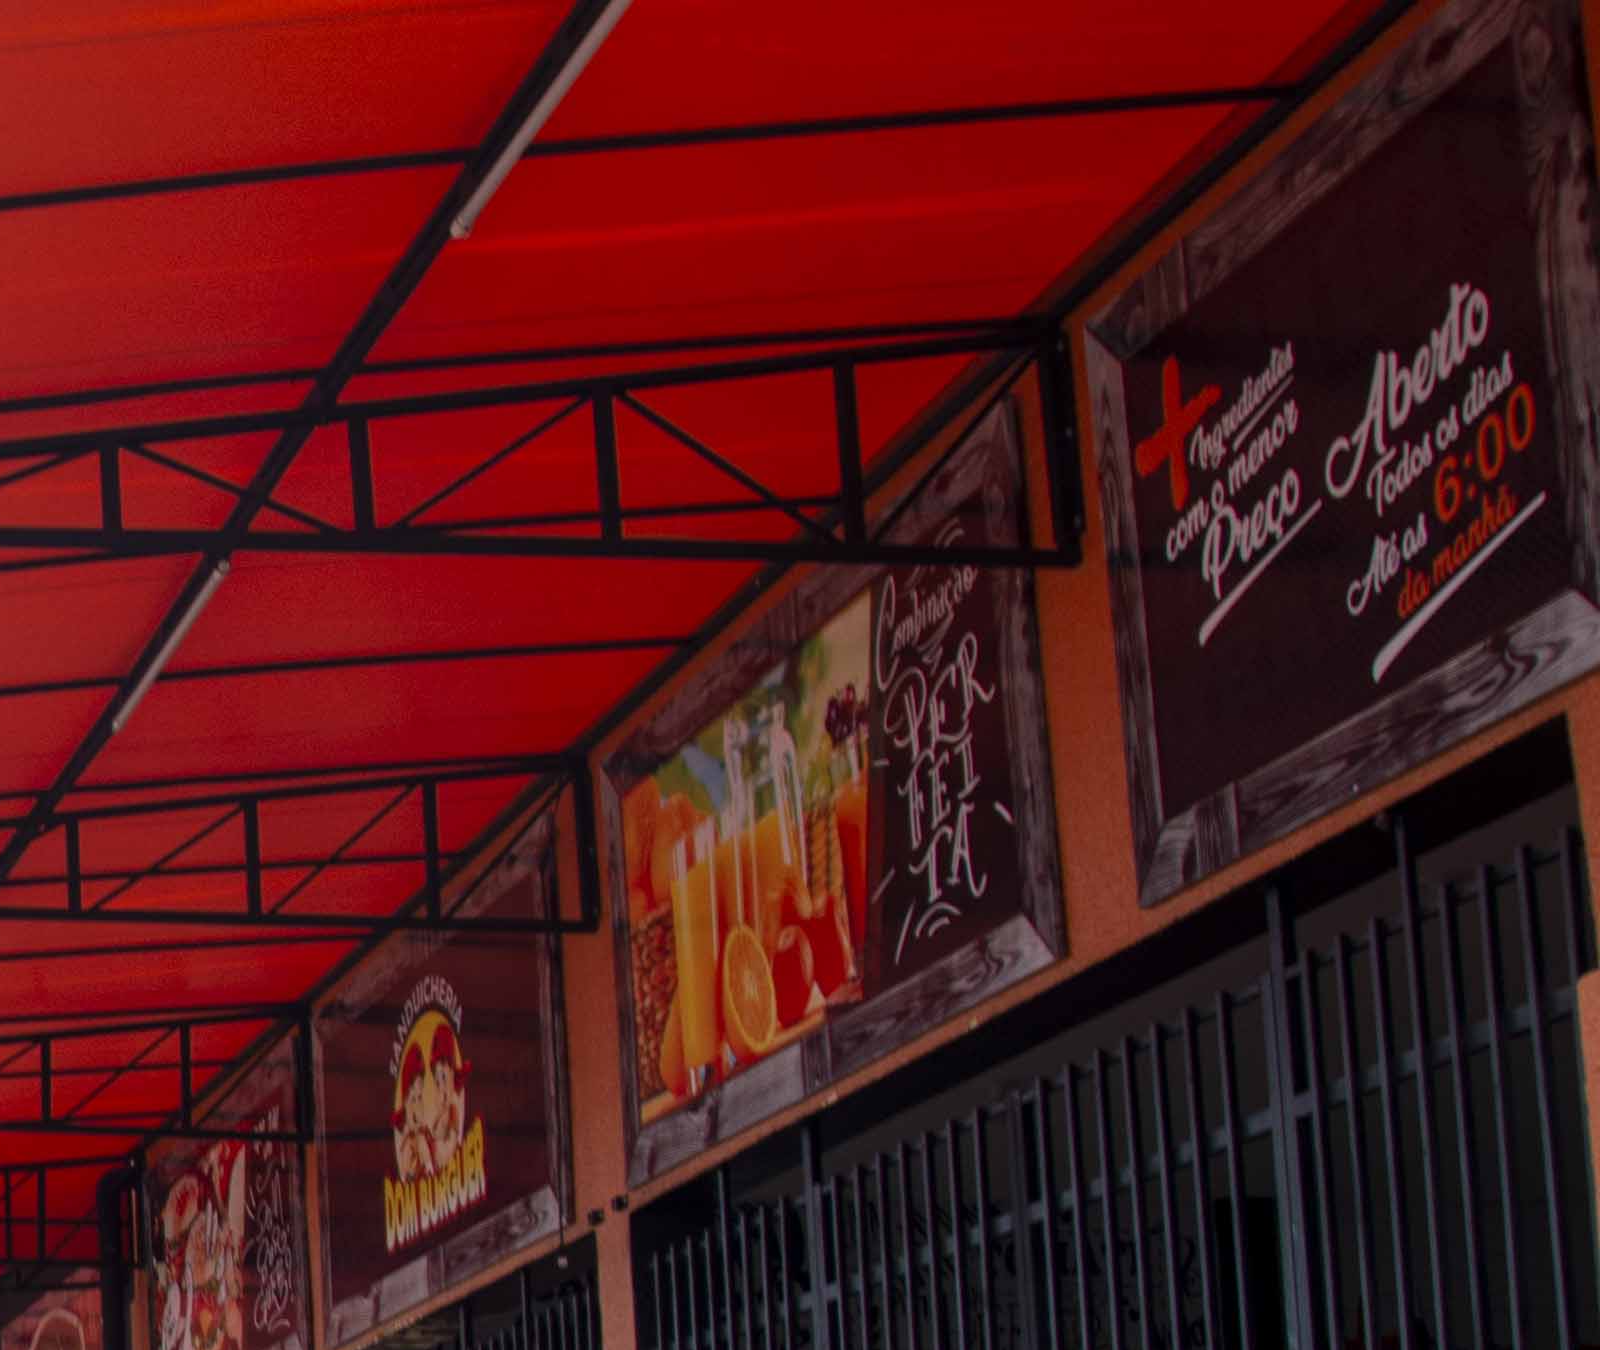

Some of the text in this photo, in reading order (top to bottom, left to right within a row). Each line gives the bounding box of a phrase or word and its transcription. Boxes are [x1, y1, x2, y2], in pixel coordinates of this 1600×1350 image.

[1190, 340, 1294, 470] Ingredientes
[1325, 282, 1490, 498] Aberto
[1367, 350, 1514, 517] Todos os dias
[1166, 399, 1299, 563] com o menor
[1202, 467, 1300, 600] Preço
[1347, 383, 1537, 616] Até as 6:00
[1398, 482, 1518, 618] da manhã
[383, 1173, 419, 1254] DOM
[419, 1114, 487, 1232] BURGUER
